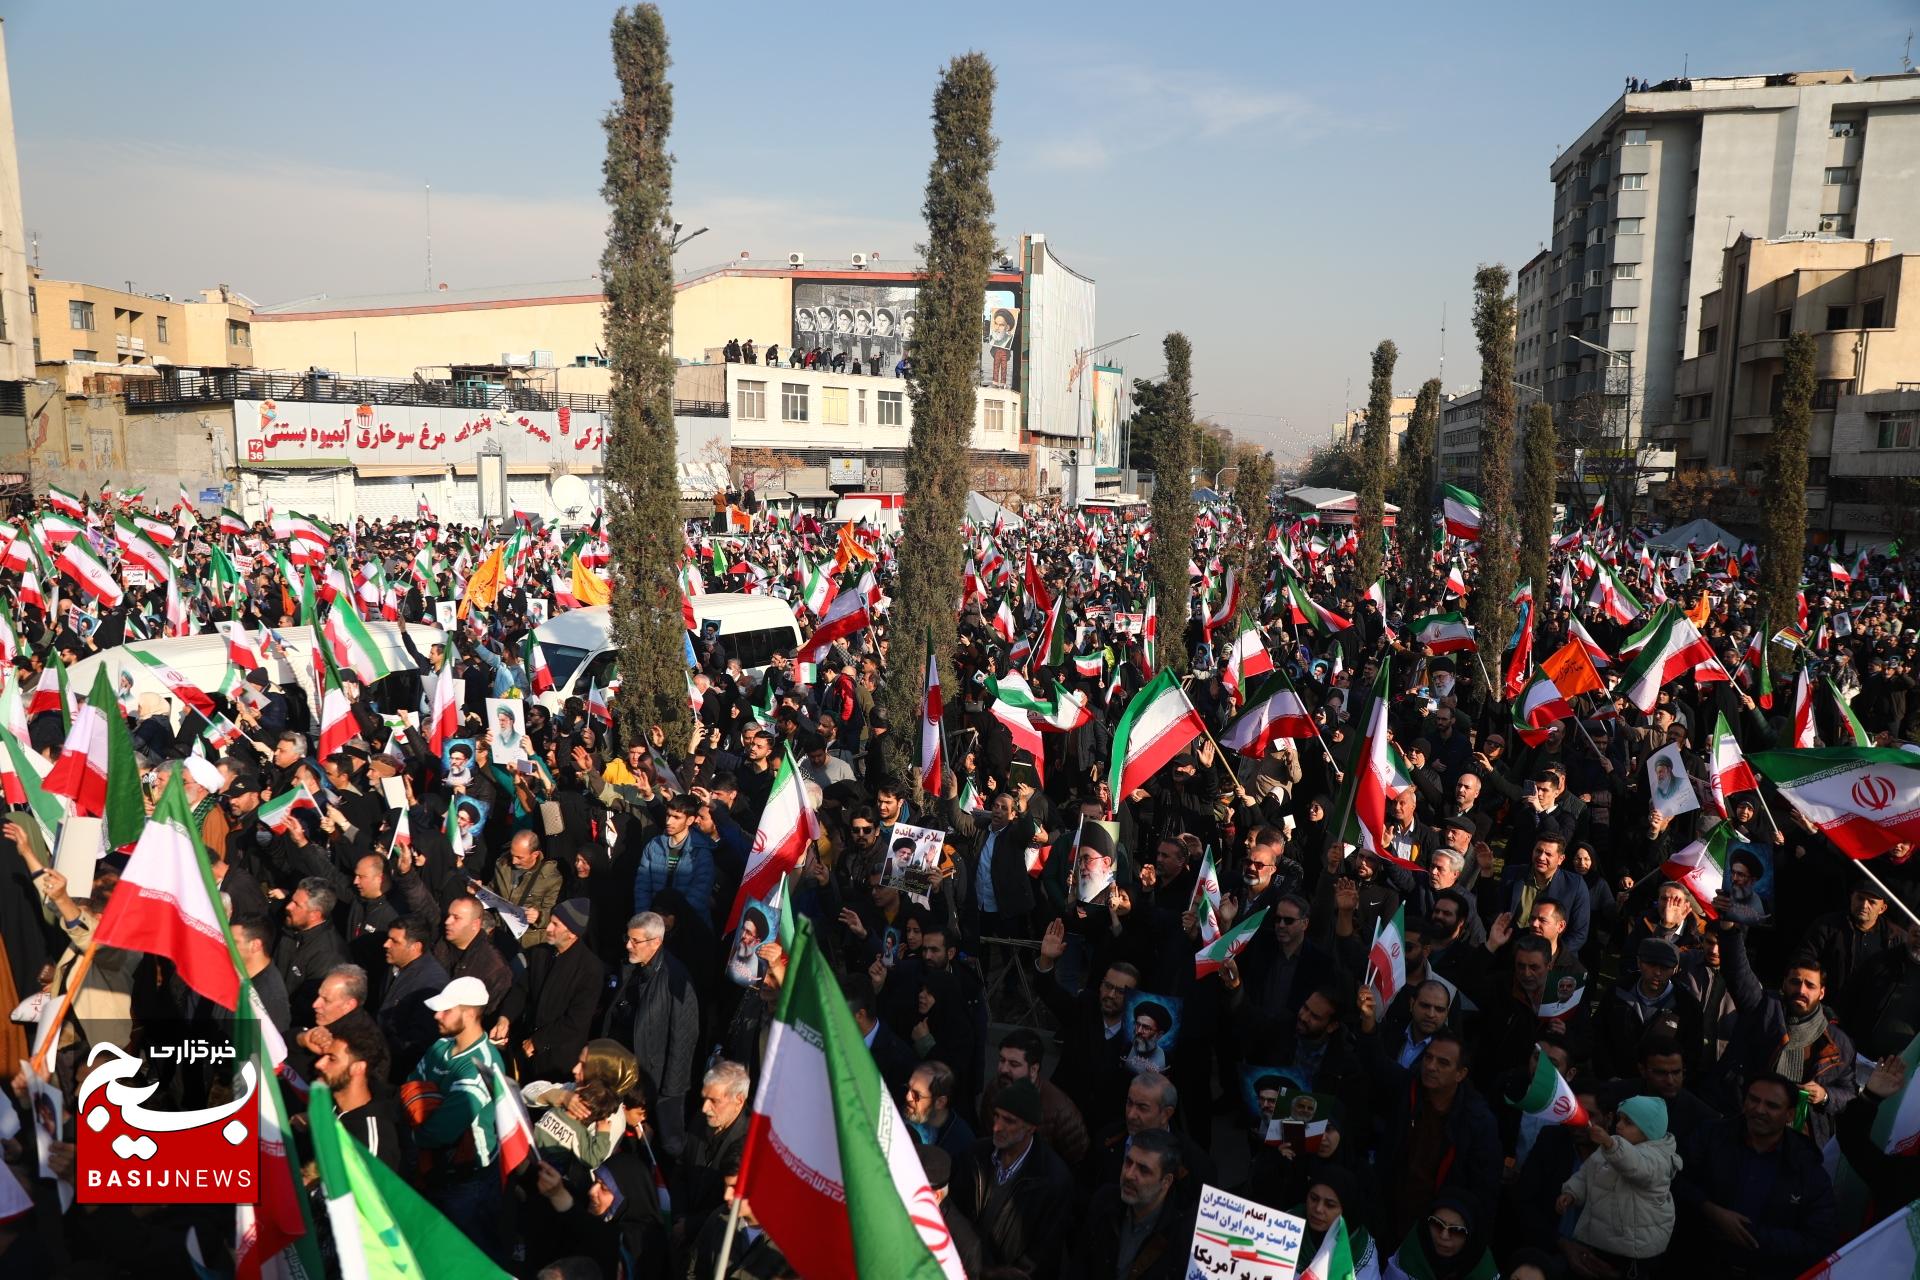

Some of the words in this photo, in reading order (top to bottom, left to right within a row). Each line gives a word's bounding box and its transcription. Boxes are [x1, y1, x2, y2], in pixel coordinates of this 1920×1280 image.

[264, 422, 307, 448] بستنی
[311, 419, 351, 449] آبمیوه
[356, 423, 415, 449] سوخاری
[418, 422, 446, 450] مرغ
[250, 451, 263, 460] 36
[895, 827, 924, 842] فرمانده
[924, 832, 942, 842] سلام
[1203, 1192, 1245, 1214] اغتشاشگران
[1200, 1207, 1219, 1221] است
[1245, 1208, 1267, 1222] اعدام
[1219, 1216, 1242, 1232] ایران
[1266, 1218, 1272, 1227] و
[1274, 1217, 1302, 1234] محاکمه
[1242, 1226, 1264, 1240] مردم
[1193, 1244, 1239, 1275] آمریکا
